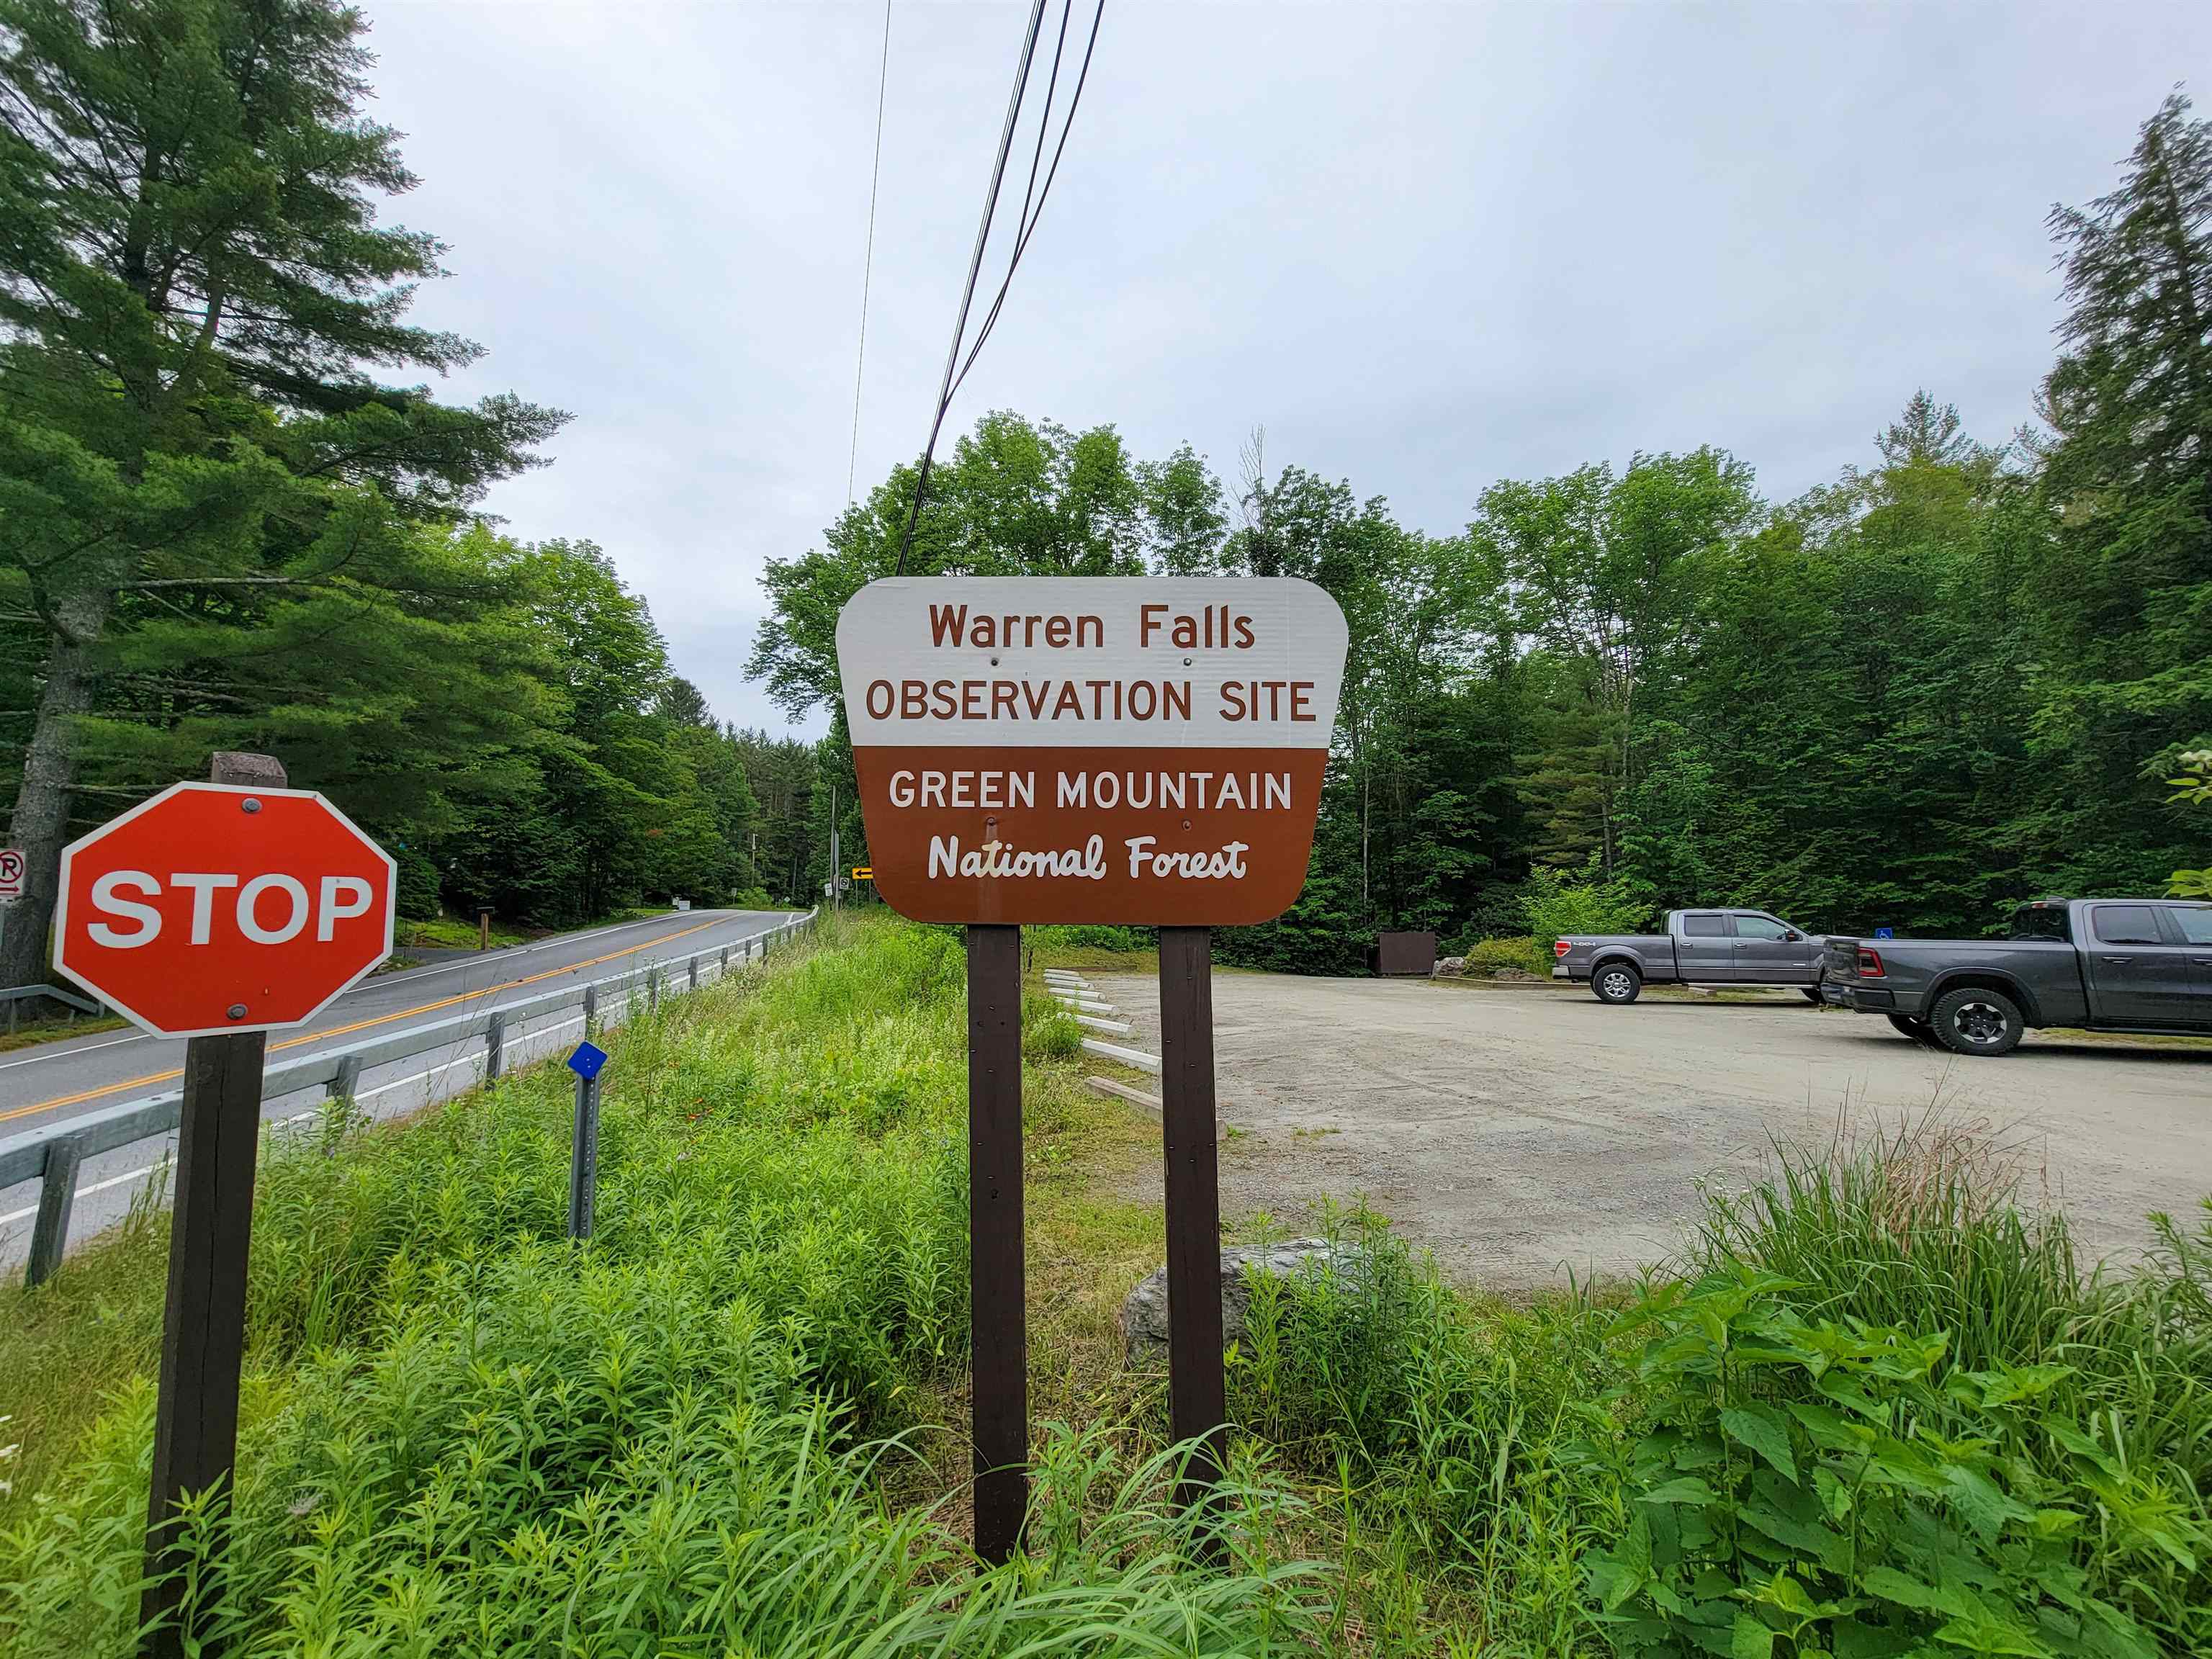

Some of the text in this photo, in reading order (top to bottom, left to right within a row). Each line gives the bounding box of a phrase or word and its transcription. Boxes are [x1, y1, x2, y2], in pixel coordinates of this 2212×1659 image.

[930, 604, 1256, 649] Warren Falls
[866, 678, 1317, 722] OBSERVATION SITE
[889, 770, 1292, 810] GREEN MOUNTAIN
[928, 834, 1250, 881] National Forest
[86, 869, 374, 950] STOP
